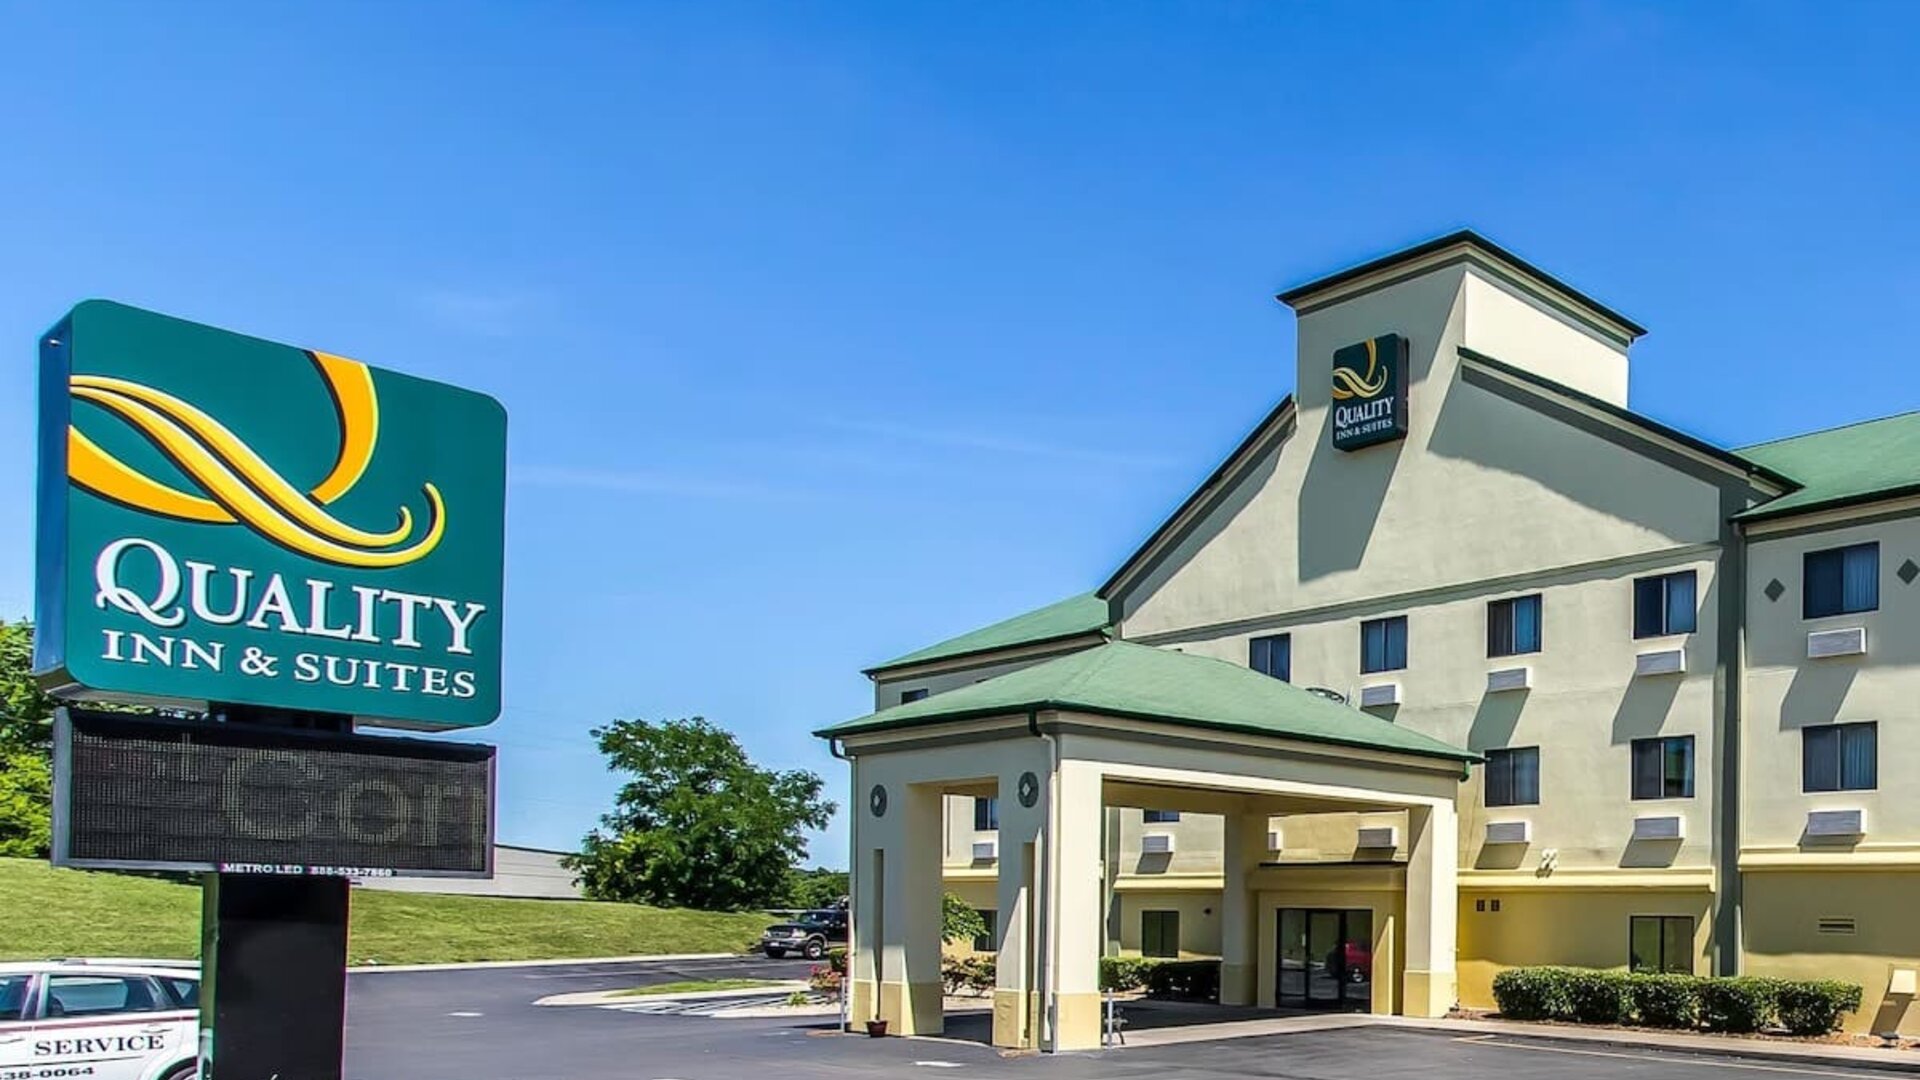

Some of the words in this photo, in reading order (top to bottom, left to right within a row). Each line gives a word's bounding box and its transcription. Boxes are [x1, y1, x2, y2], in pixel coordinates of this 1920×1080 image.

[1335, 397, 1394, 428] QUALITY
[1336, 428, 1353, 440] INN
[1361, 418, 1393, 434] SUITES
[96, 538, 486, 655] QUALITY
[102, 630, 224, 671] INN
[240, 647, 279, 677] &
[293, 653, 476, 698] SUITES
[223, 862, 273, 874] METRO
[276, 864, 303, 875] LED
[34, 1035, 165, 1056] SERVICE
[0, 1067, 94, 1080] 38-0064
